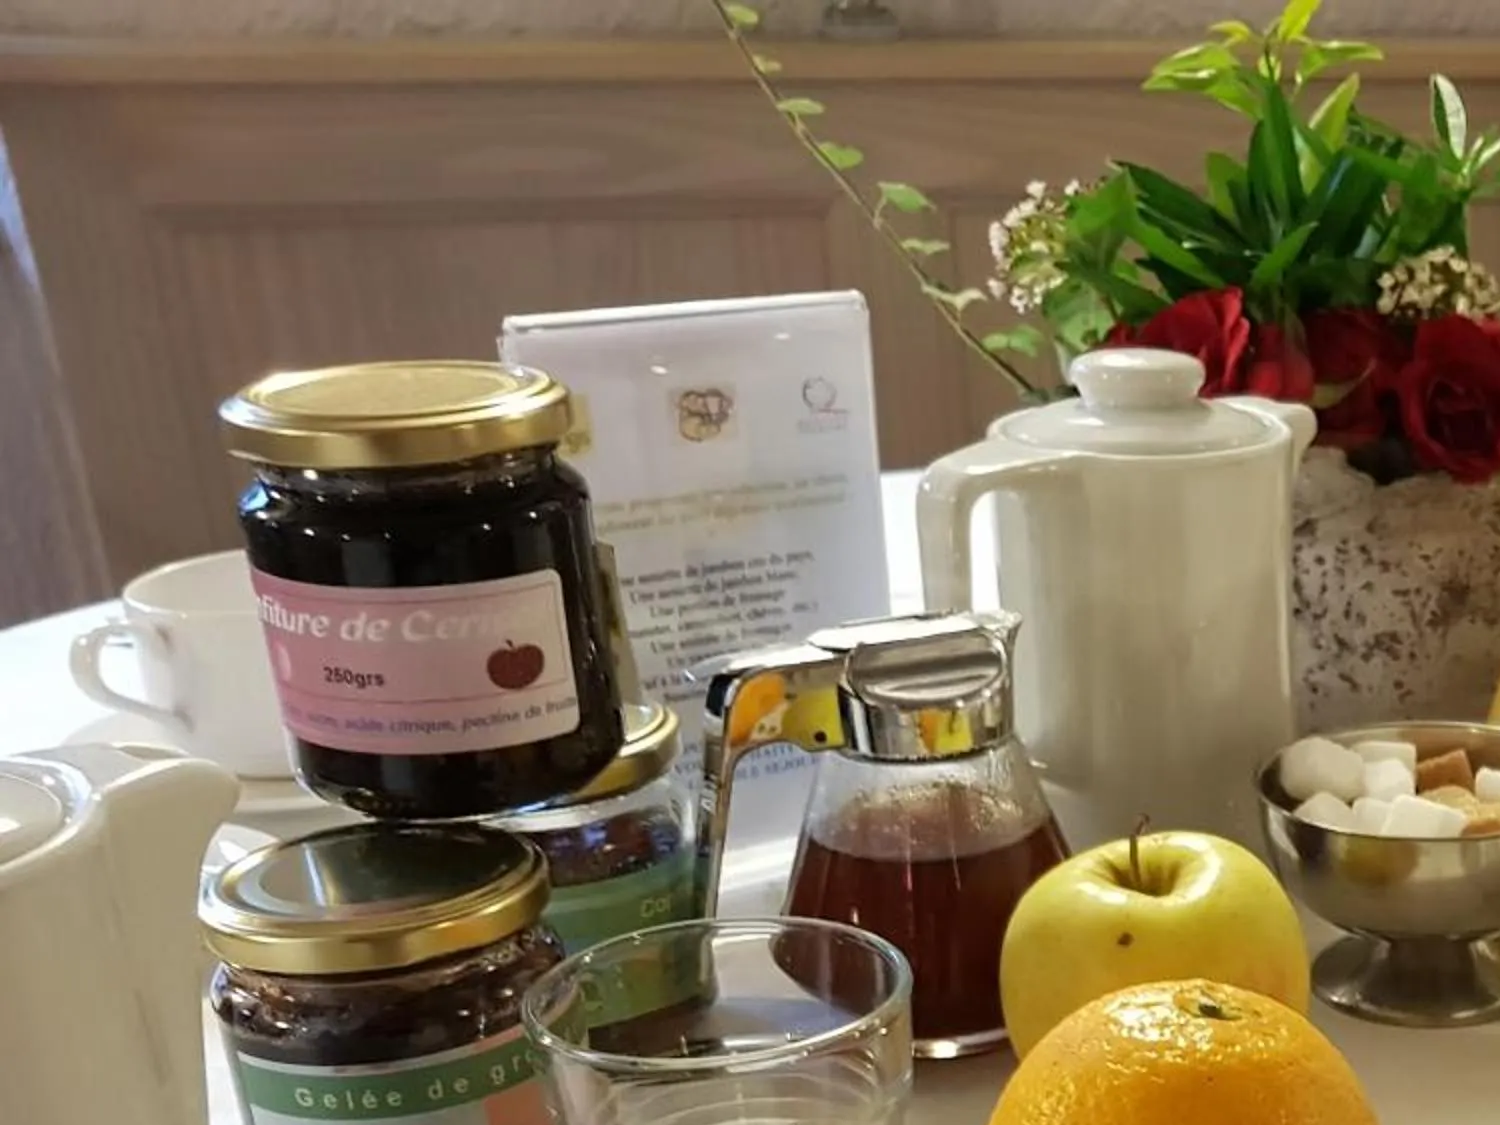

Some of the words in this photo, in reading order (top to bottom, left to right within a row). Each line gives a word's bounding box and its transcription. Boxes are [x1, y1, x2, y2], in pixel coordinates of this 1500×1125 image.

[340, 611, 392, 642] de
[322, 666, 386, 690] 250grs
[524, 704, 542, 719] de
[294, 1087, 402, 1110] Gelée
[428, 1077, 469, 1101] de
